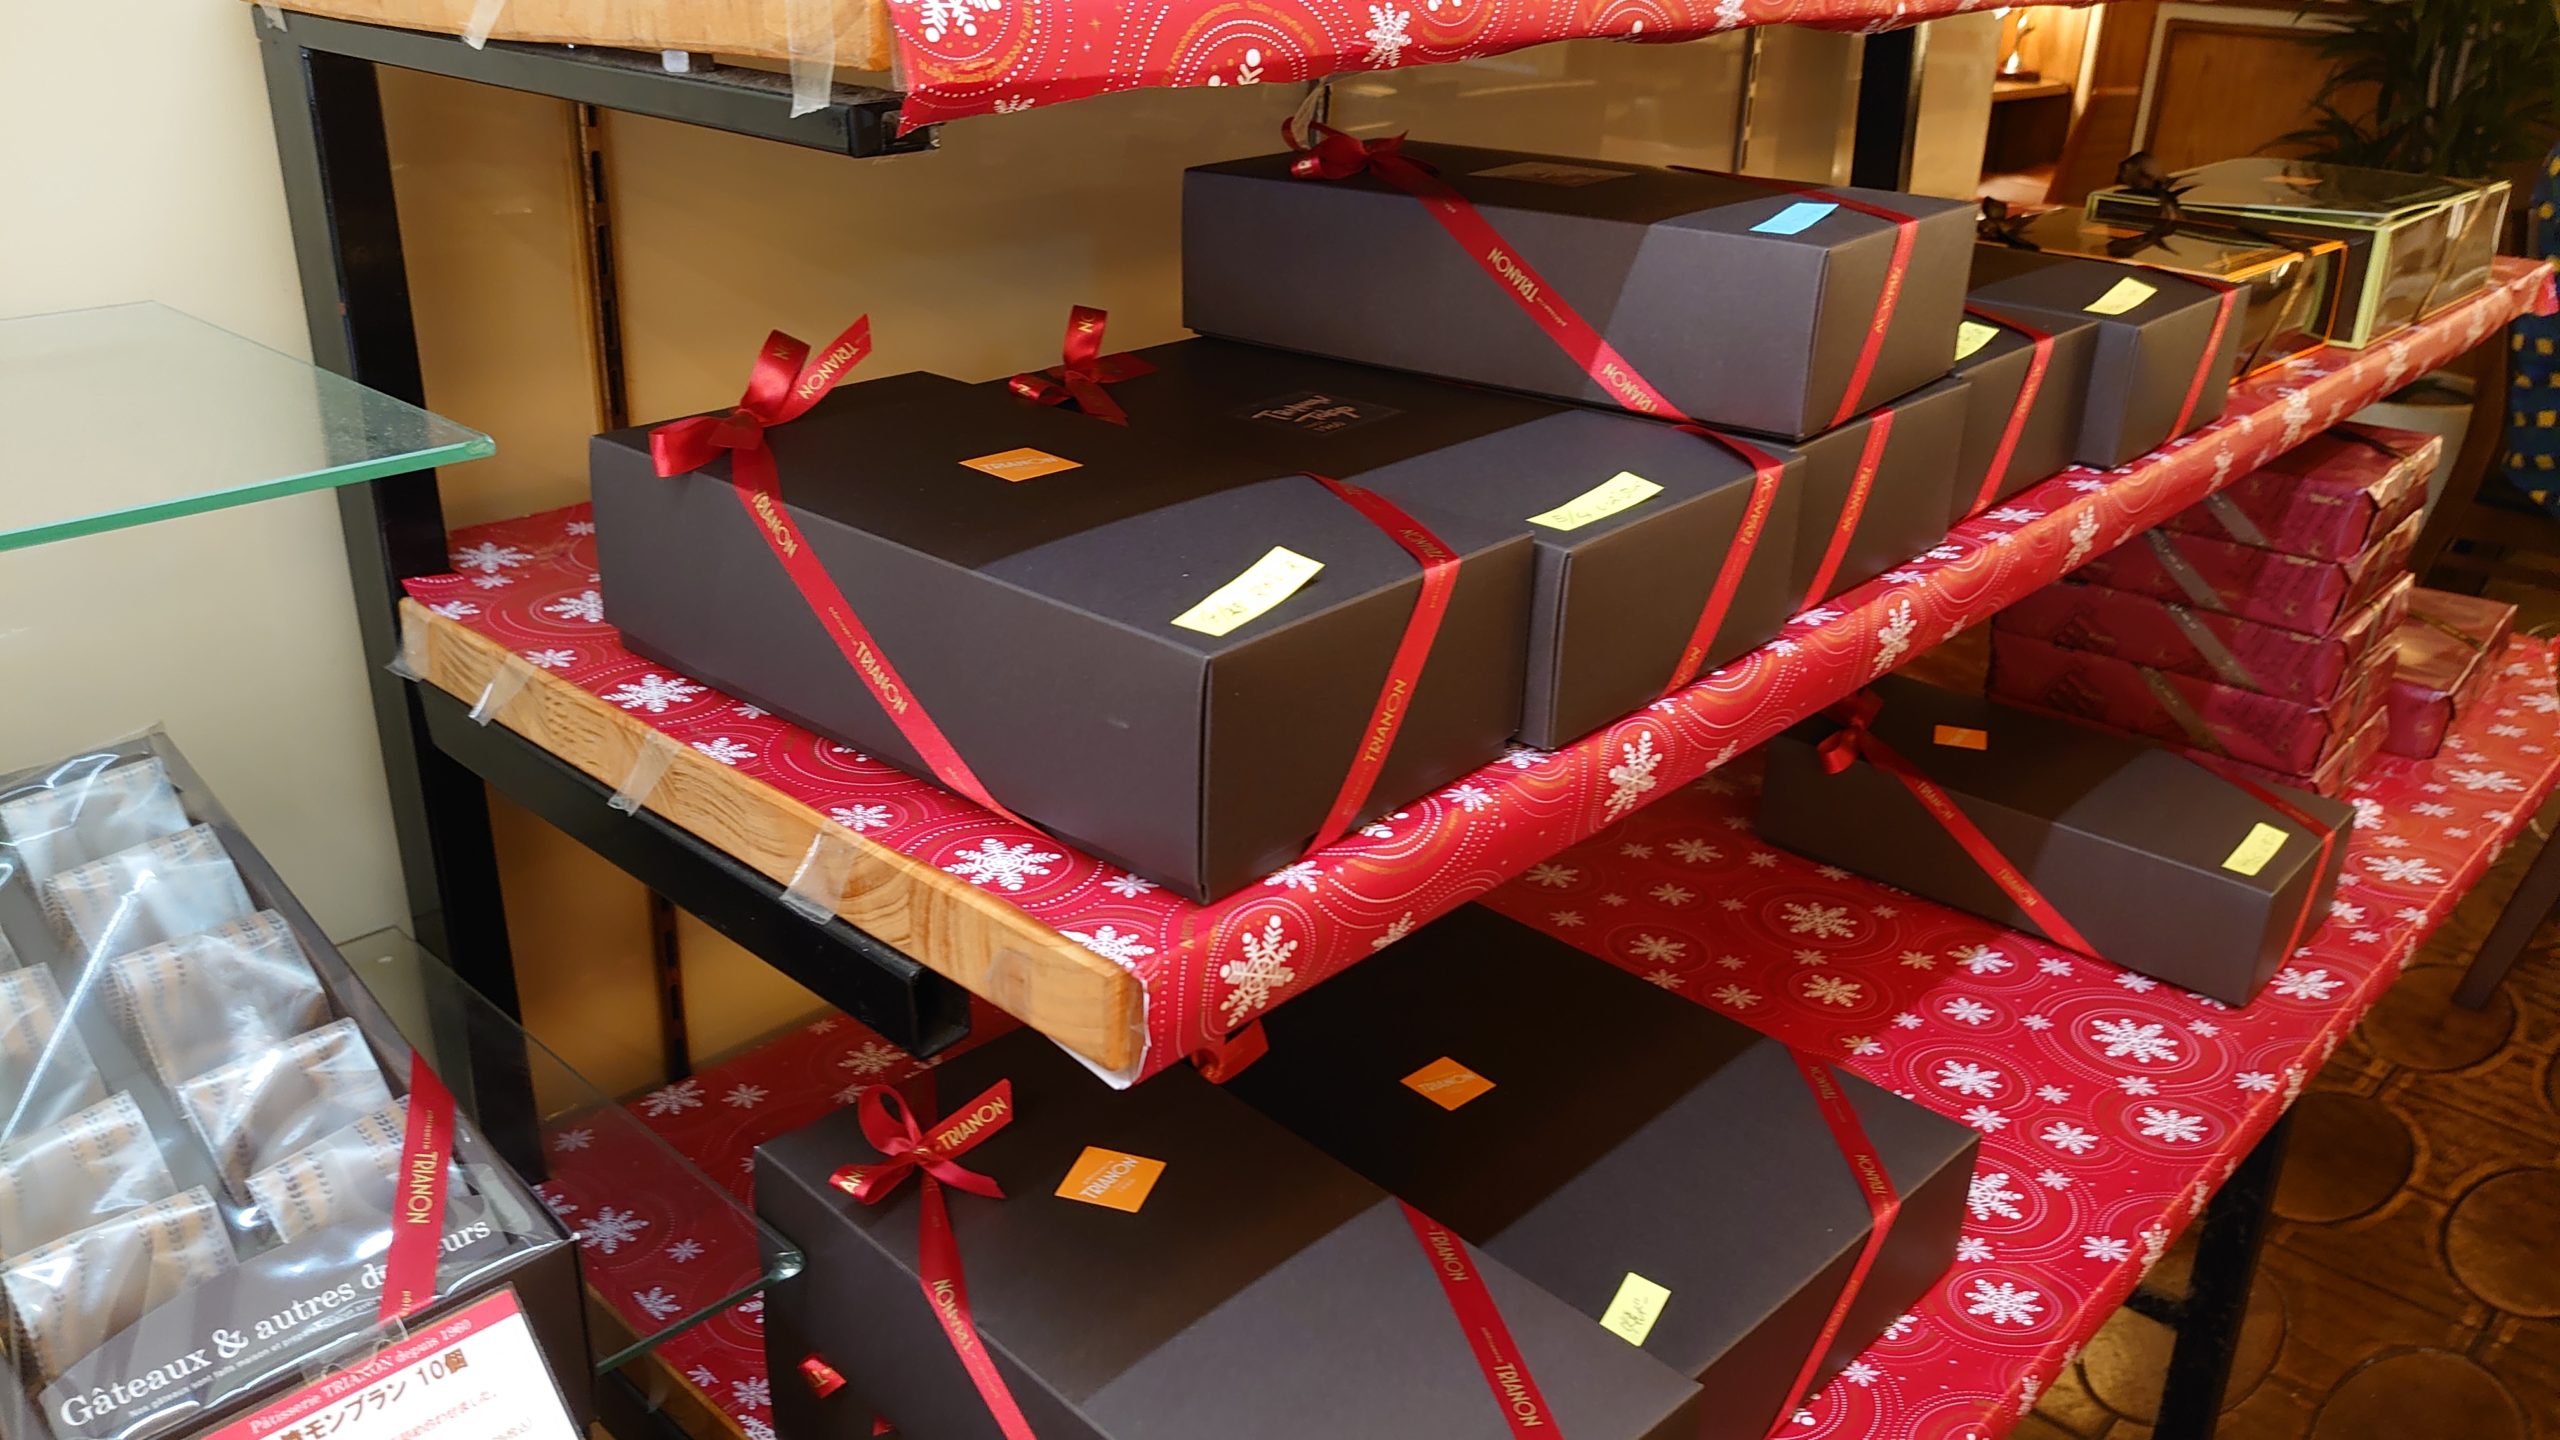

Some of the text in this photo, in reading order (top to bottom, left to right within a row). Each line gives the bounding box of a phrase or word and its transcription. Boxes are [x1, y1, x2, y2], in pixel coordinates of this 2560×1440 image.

[1487, 247, 1539, 302] TRIANON
[797, 342, 859, 399] TRIANON
[752, 490, 798, 558] TRIANON
[855, 641, 909, 715] TRIANON
[1363, 679, 1407, 762] TRIANON
[1417, 1070, 1477, 1094] TRIANON
[937, 1096, 1009, 1151] TRIANON
[406, 1151, 439, 1225] TRIANON
[1079, 1156, 1139, 1199] TRIANON
[1428, 1229, 1470, 1282] TRIANON
[60, 1348, 213, 1427] Gâteaux
[212, 1328, 249, 1359] &
[254, 1280, 357, 1341] autres
[320, 1354, 397, 1398] TRIANON
[1493, 1362, 1544, 1427] TRIANON
